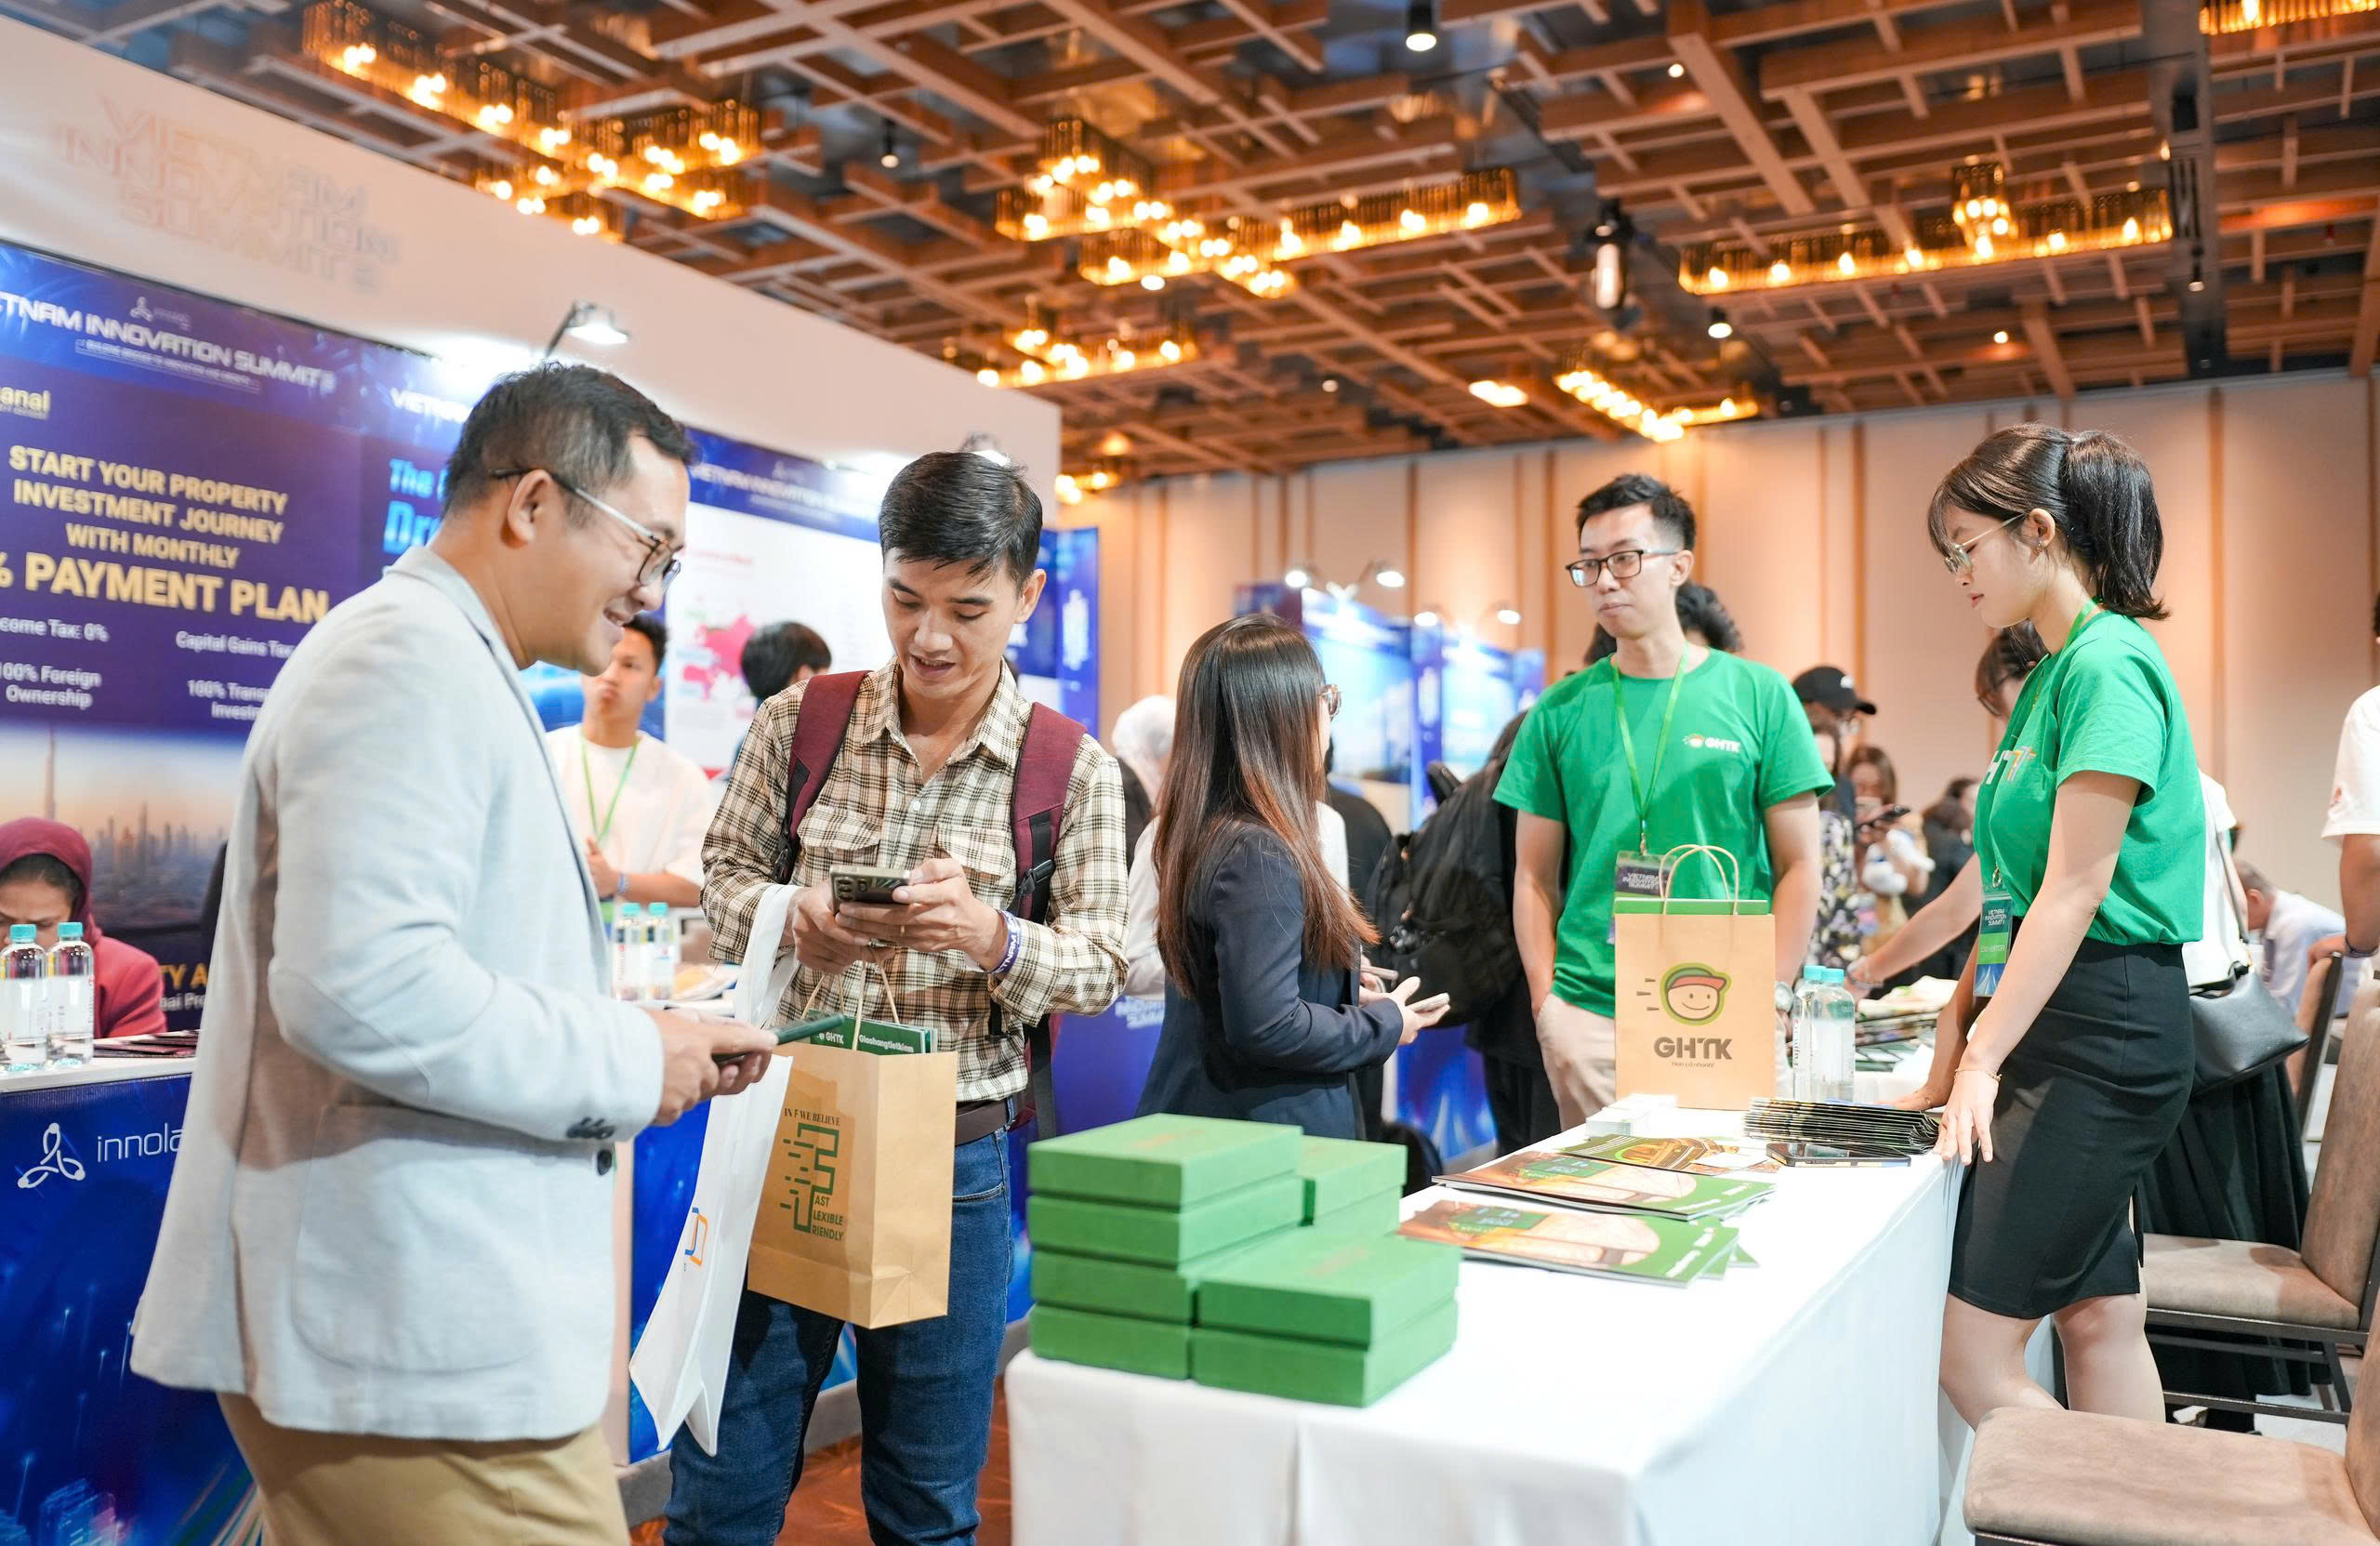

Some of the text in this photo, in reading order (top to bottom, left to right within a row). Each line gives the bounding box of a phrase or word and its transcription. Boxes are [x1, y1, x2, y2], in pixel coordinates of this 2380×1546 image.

[0, 290, 82, 332] TNAM
[85, 312, 231, 367] INNOVATION
[9, 445, 288, 514] START YOUR PROPERTY
[389, 458, 434, 498] The
[14, 479, 284, 544] INVESTMENT JOURNEY
[66, 522, 239, 568] WITH MONTHLY
[25, 552, 223, 612] PAYMENT
[231, 580, 329, 624] PLAN
[84, 623, 110, 641] 0%
[176, 630, 226, 653] Capital
[228, 636, 268, 657] Gains
[41, 666, 102, 690] Foreign
[188, 680, 226, 699] 100%
[6, 684, 94, 710] Ownership
[1705, 736, 1740, 753] GHTK
[826, 1031, 844, 1044] GHTK
[1654, 1037, 1732, 1059] GHTK
[785, 1107, 840, 1127] IN F WE BELIEVE
[815, 1196, 830, 1208] AST
[813, 1209, 843, 1225] LEXIBLE
[812, 1224, 844, 1241] RIENDLY
